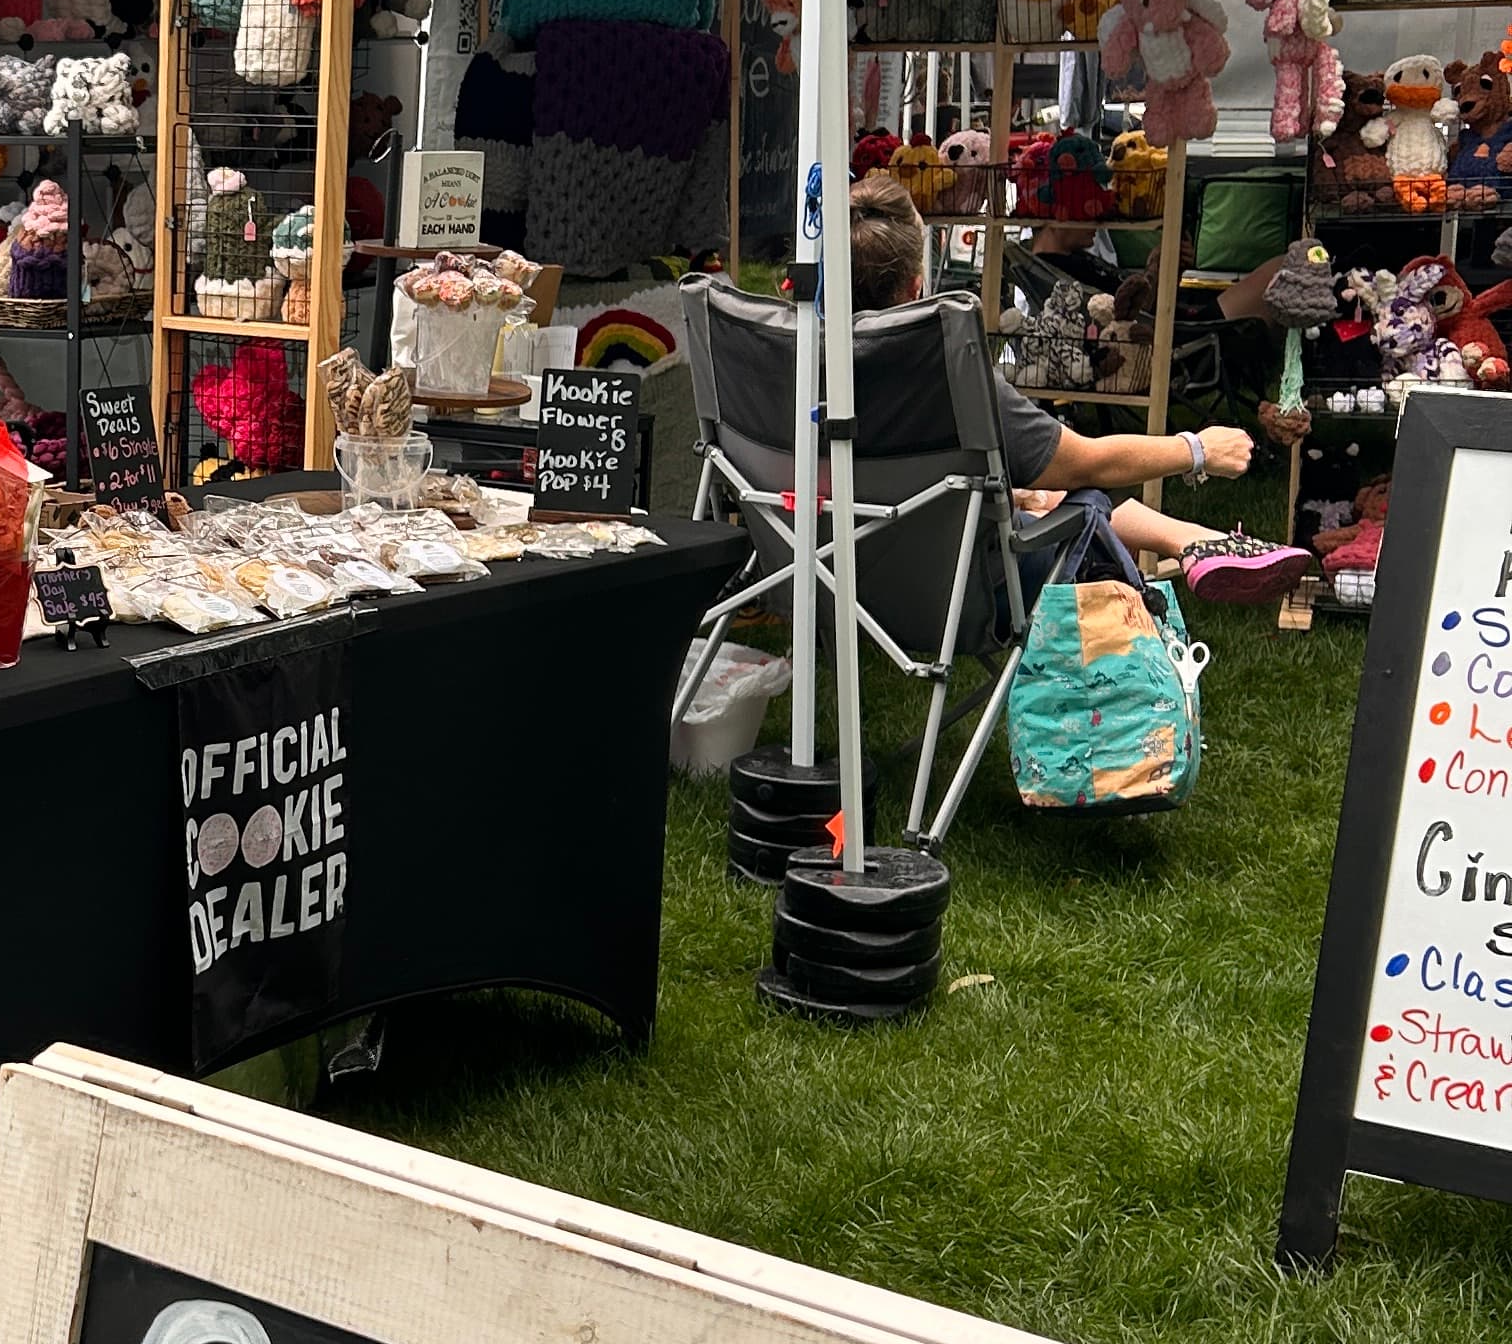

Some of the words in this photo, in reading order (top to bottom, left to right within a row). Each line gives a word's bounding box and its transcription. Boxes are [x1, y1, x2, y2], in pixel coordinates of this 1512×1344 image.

[421, 224, 445, 235] EACH
[448, 223, 476, 234] HAND
[86, 391, 136, 417] Sweet
[120, 437, 158, 458] Single
[110, 472, 123, 490] 2
[124, 470, 139, 487] for
[584, 474, 611, 500] $4
[141, 496, 149, 511] 5
[41, 584, 67, 600] Day
[44, 600, 78, 616] Sale
[181, 707, 346, 807] OFFICIAL
[186, 774, 345, 889] COOKIE
[189, 852, 347, 975] DEALER
